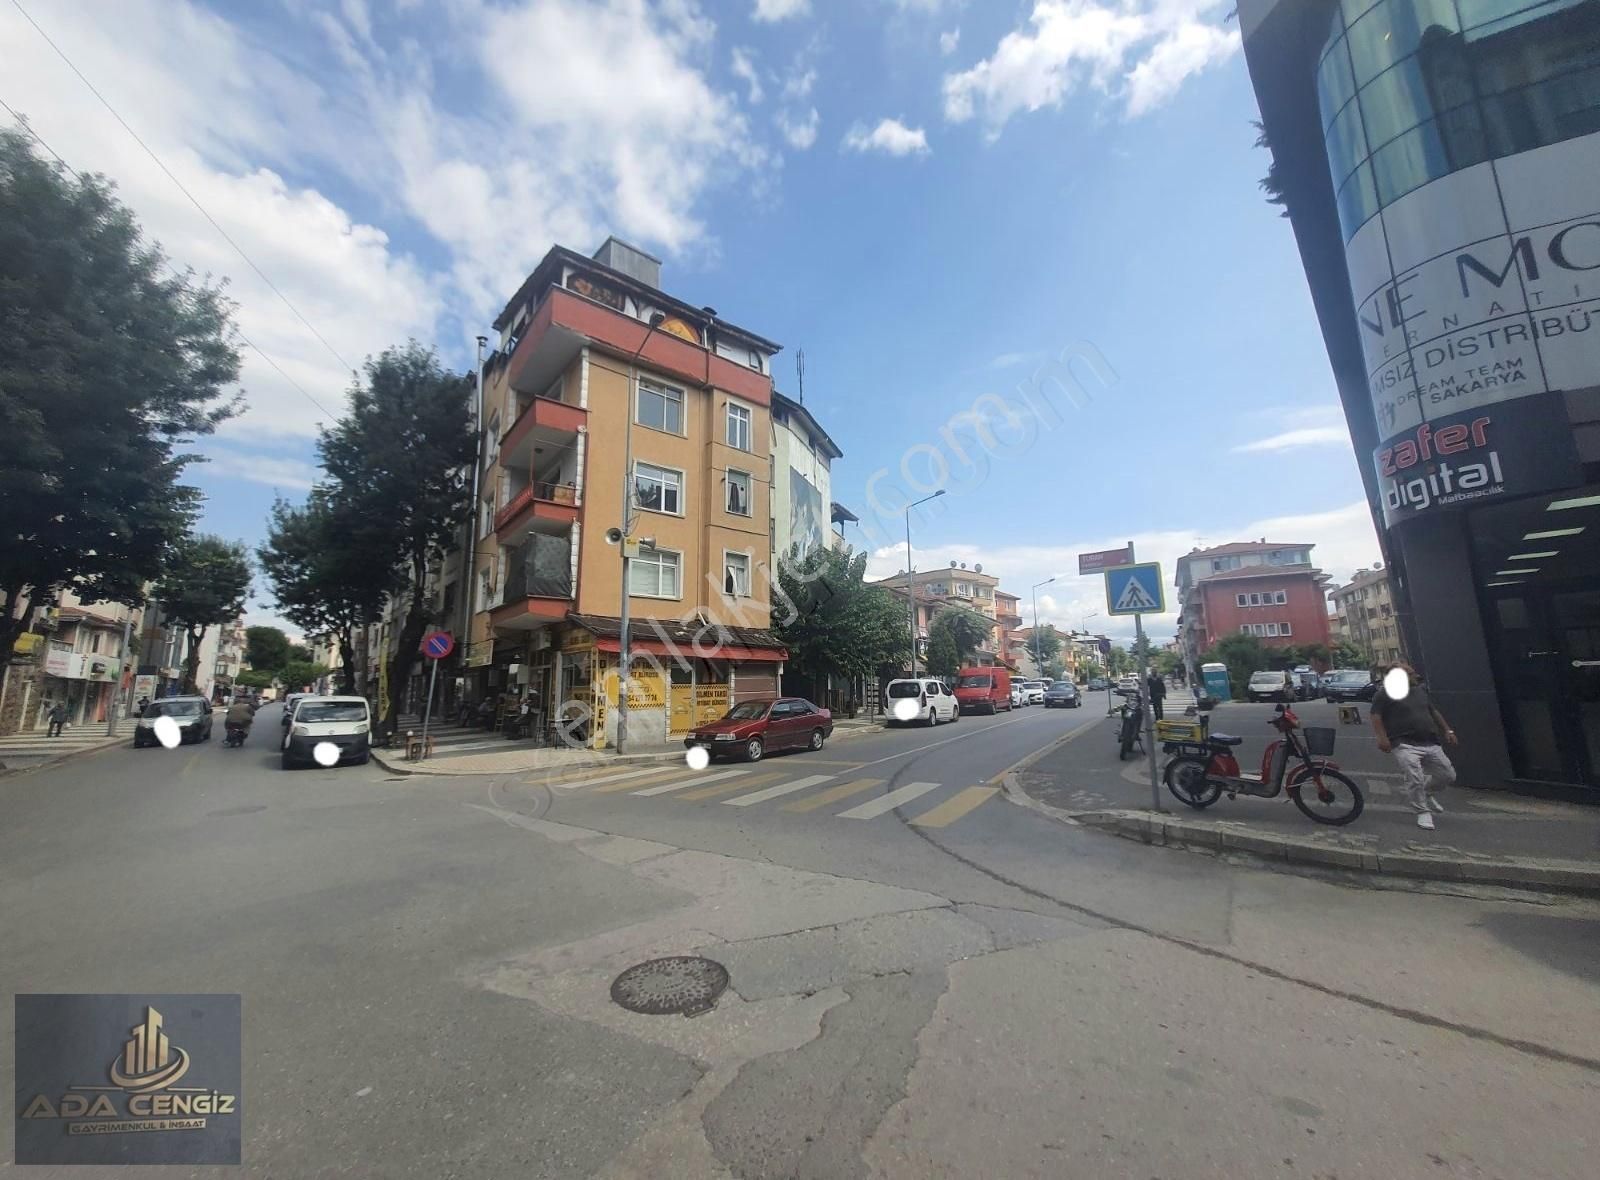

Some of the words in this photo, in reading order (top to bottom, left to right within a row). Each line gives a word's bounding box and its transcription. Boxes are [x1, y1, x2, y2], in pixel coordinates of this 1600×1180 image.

[1431, 369, 1527, 404] SAKARYA
[1468, 357, 1524, 378] TEAM
[1380, 416, 1490, 477] zafer
[1386, 451, 1504, 511] digital
